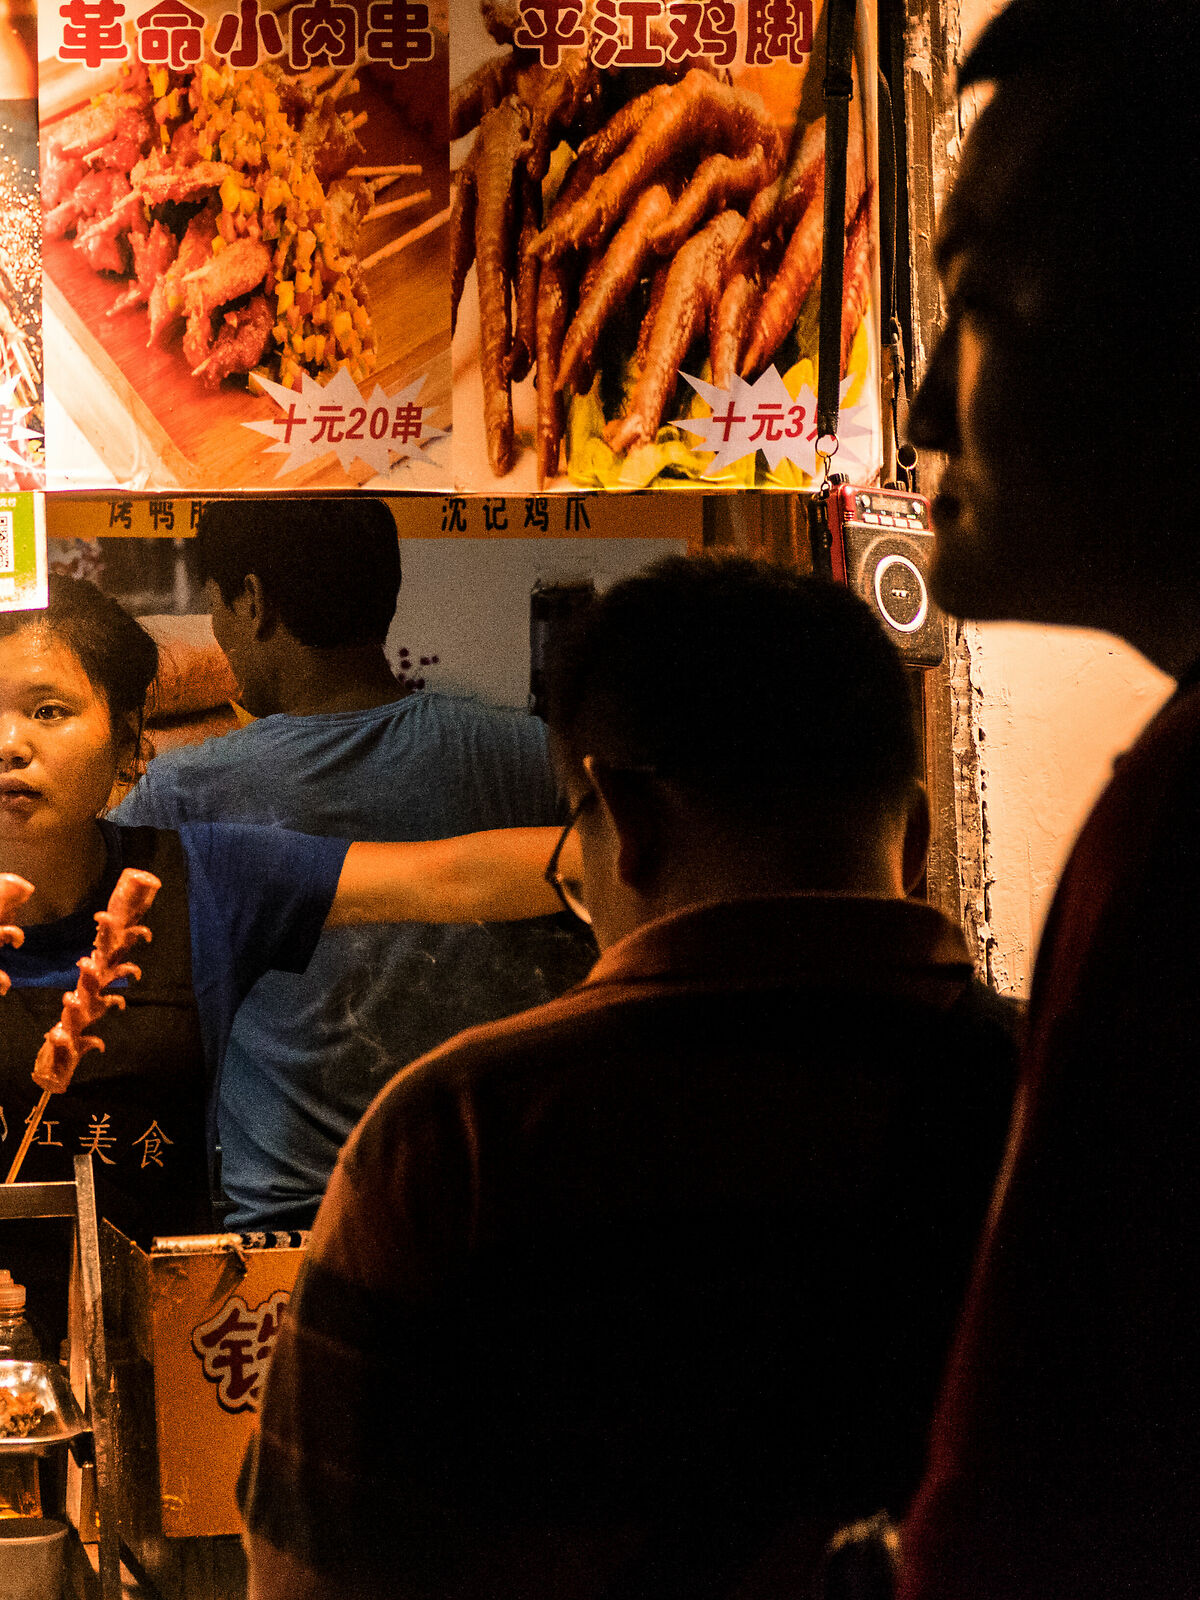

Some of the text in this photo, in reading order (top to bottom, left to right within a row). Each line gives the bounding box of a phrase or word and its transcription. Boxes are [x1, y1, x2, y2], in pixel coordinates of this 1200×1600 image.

[58, 0, 436, 71] 革命小肉串
[514, 0, 814, 69] 平江鸡脚
[272, 402, 425, 445] 十元20串
